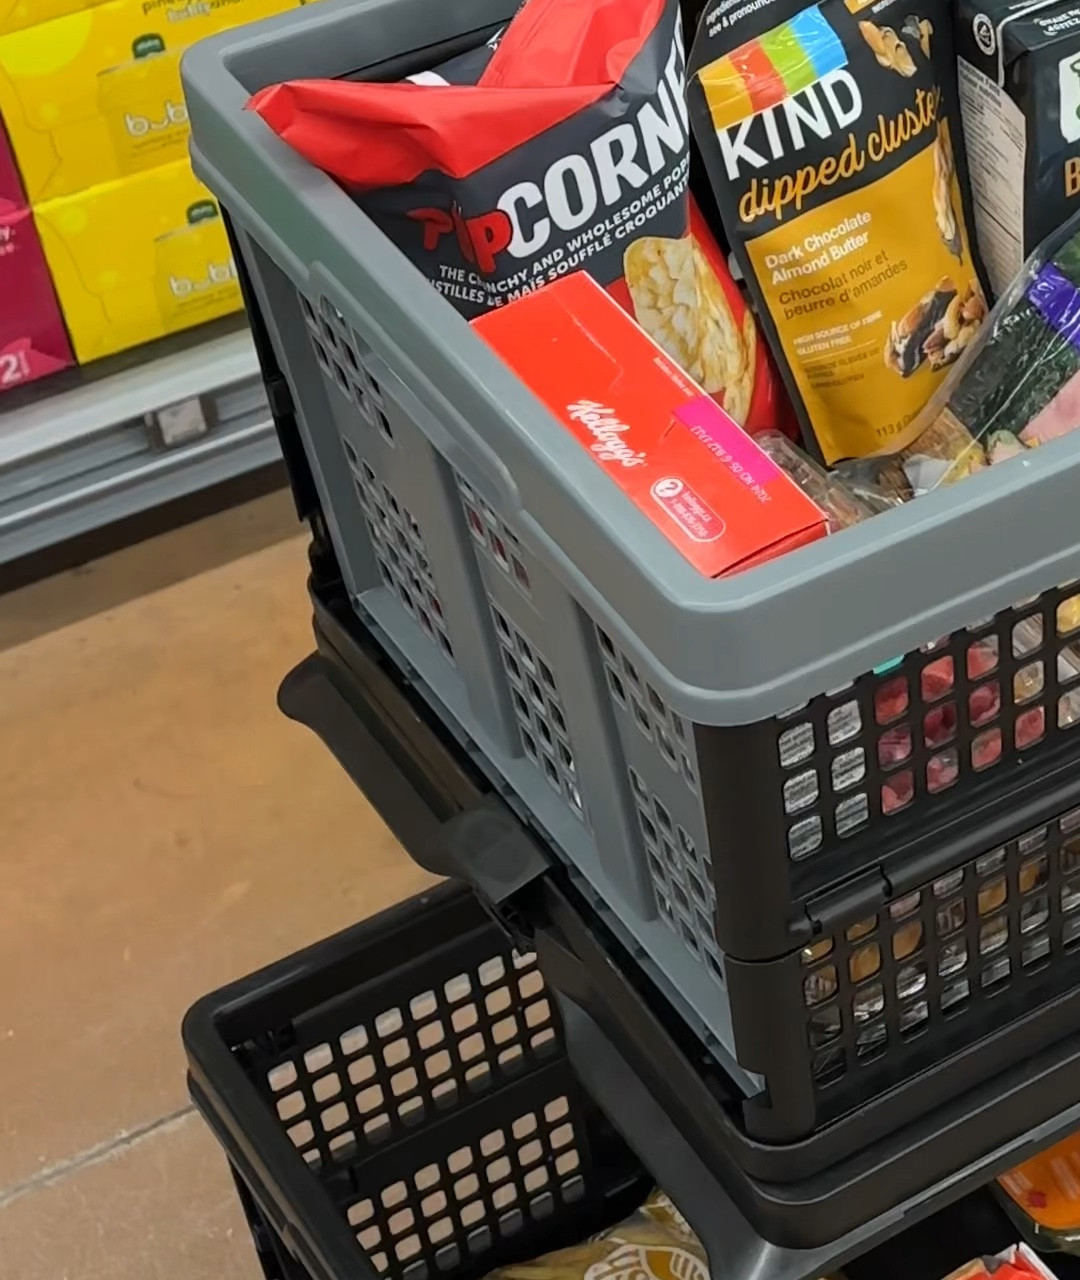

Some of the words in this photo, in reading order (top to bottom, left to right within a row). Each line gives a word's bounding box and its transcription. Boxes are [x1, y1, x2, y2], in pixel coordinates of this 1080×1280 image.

[124, 101, 189, 137] bub
[717, 69, 862, 180] KIND
[738, 132, 867, 223] dipped
[439, 265, 465, 282] THE
[470, 268, 528, 295] CNCHY
[532, 247, 564, 273] AND
[565, 184, 661, 252] WHOLESOME
[663, 151, 690, 189] POP
[765, 246, 804, 268] Dark
[804, 211, 873, 252] Chocolate
[429, 279, 484, 305] STILLES
[547, 233, 613, 279] SOUFFLÉ
[772, 252, 830, 285] Almond
[831, 232, 870, 260] Butter
[779, 274, 848, 305] Chocolat
[850, 260, 873, 280] noir
[875, 249, 889, 266] et
[784, 298, 835, 320] beurre
[839, 259, 908, 303] d'amandes
[566, 399, 647, 467] Kellogg's
